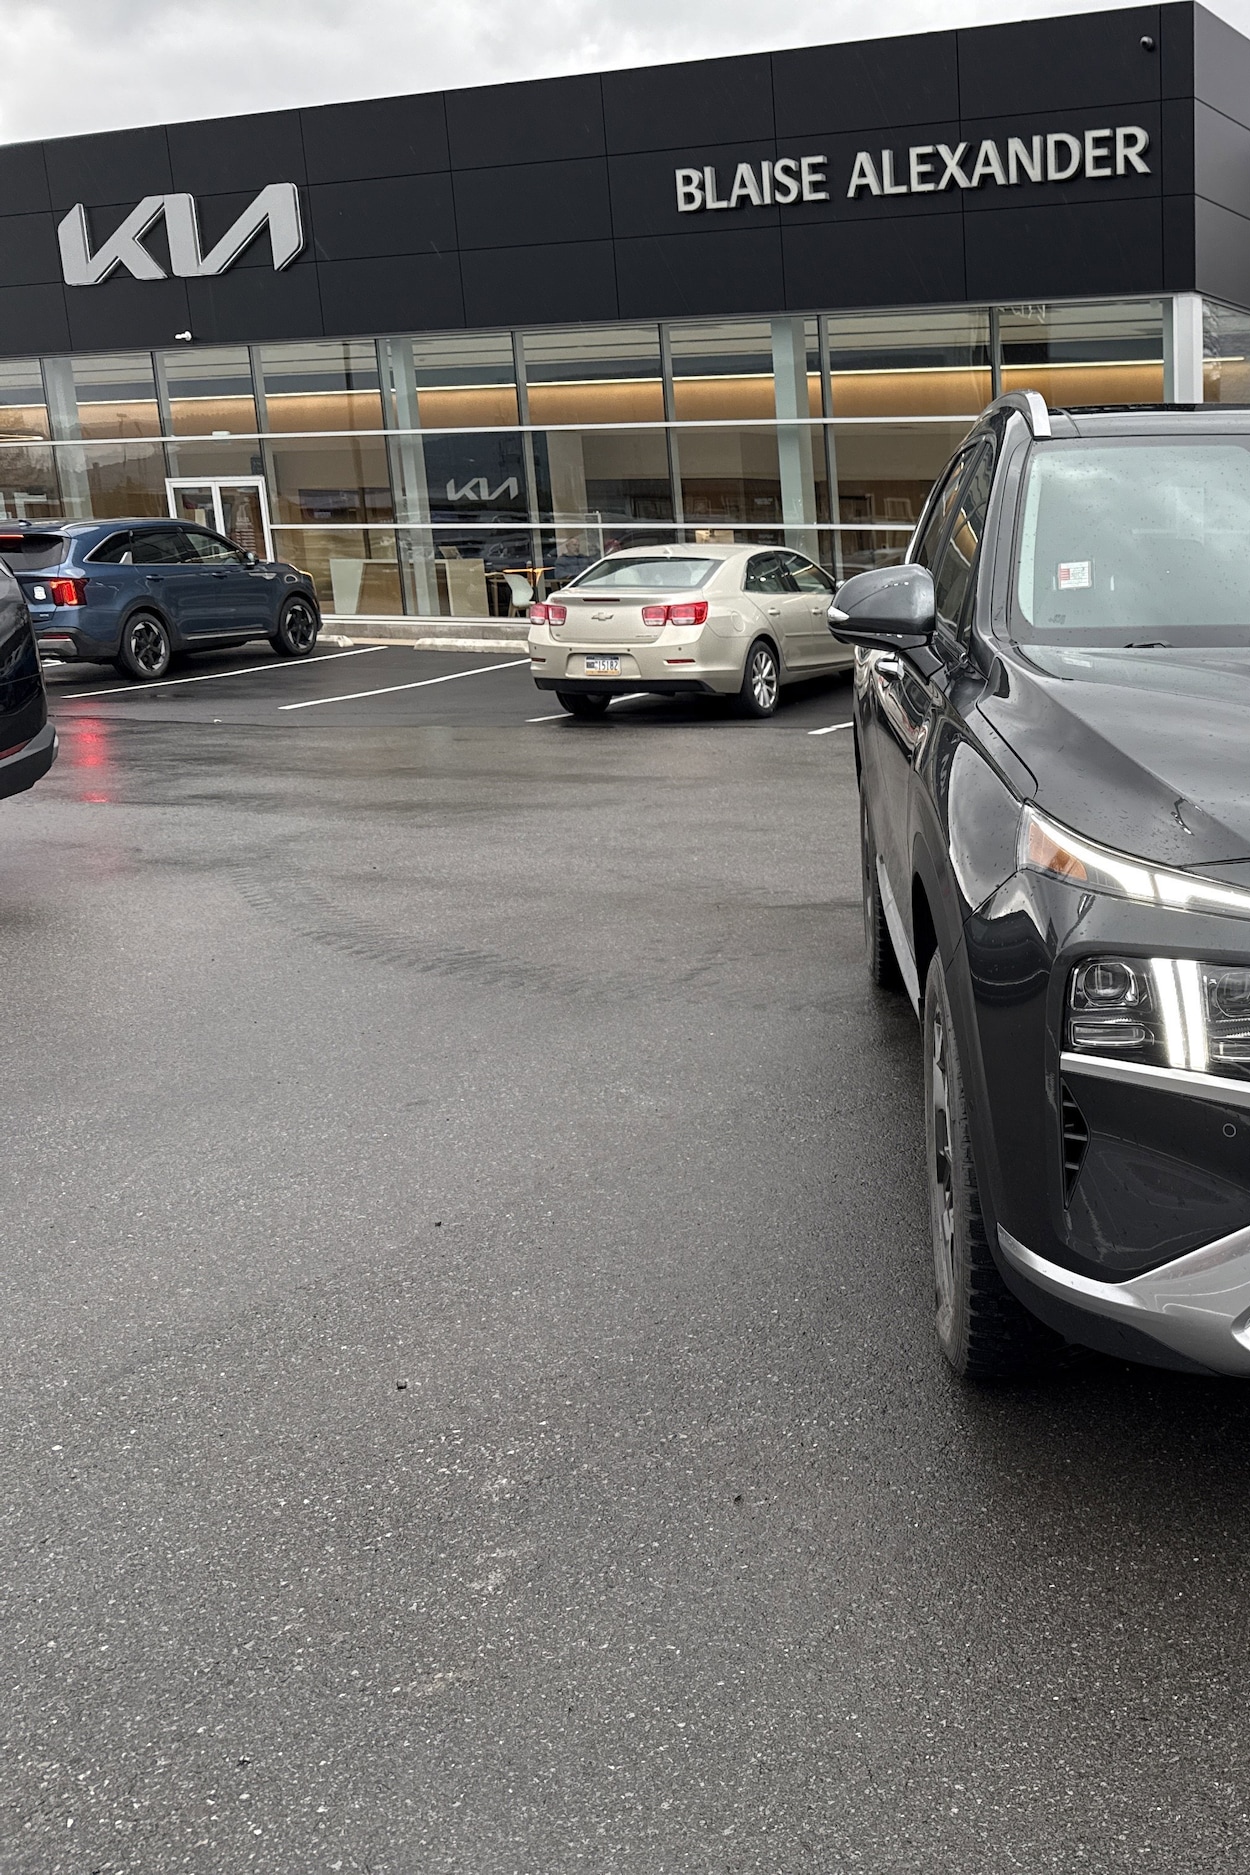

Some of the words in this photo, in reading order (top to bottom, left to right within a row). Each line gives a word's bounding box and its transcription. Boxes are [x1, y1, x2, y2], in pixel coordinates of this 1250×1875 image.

[675, 155, 830, 212] BLAISE
[847, 125, 1152, 198] ALEXANDER
[57, 182, 304, 287] KIA
[446, 476, 519, 501] KIA
